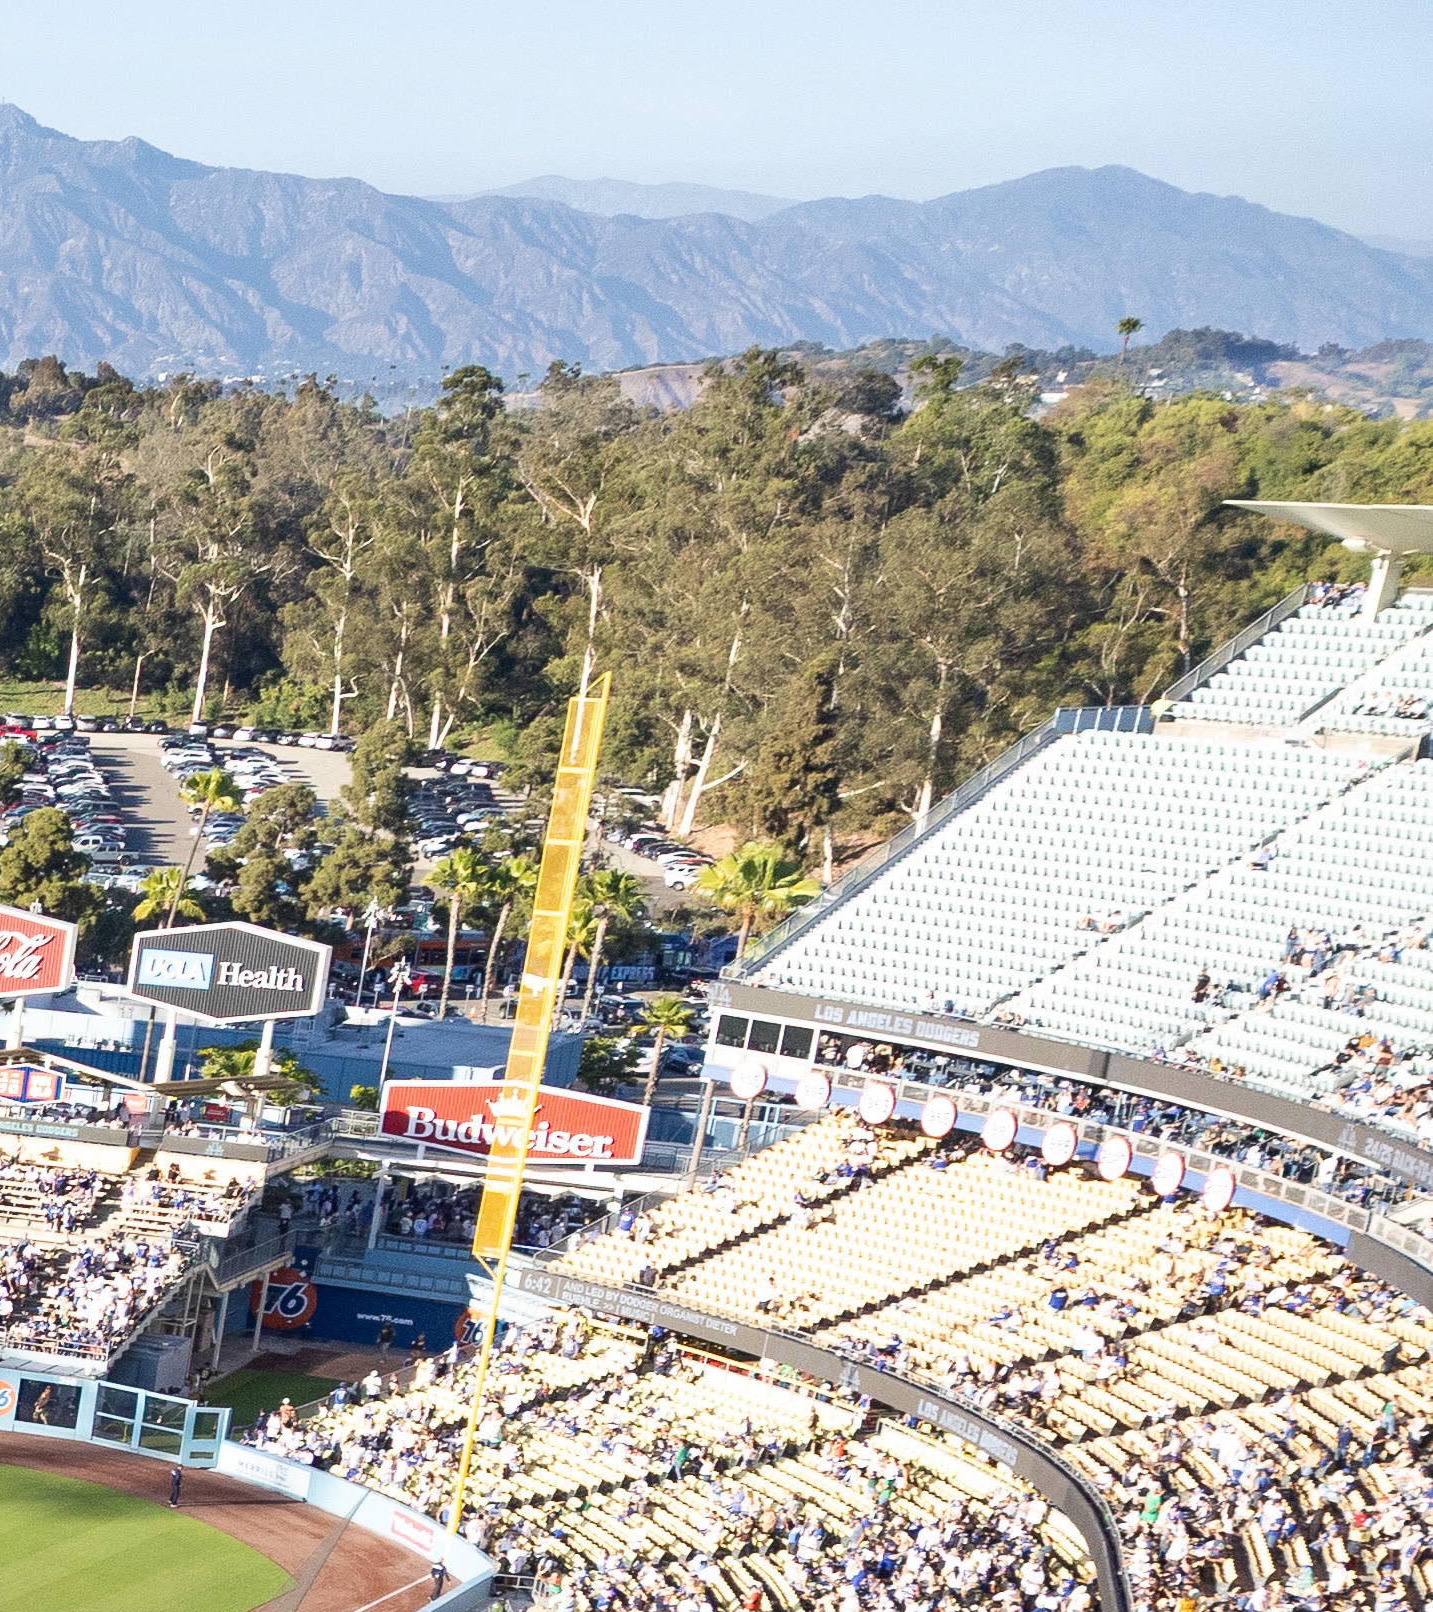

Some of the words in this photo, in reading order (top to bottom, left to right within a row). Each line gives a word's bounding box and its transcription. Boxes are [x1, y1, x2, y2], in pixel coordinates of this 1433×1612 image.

[145, 956, 207, 982] UCLA
[218, 961, 304, 993] Health
[264, 1283, 309, 1318] 76
[524, 1276, 552, 1295] 6:42
